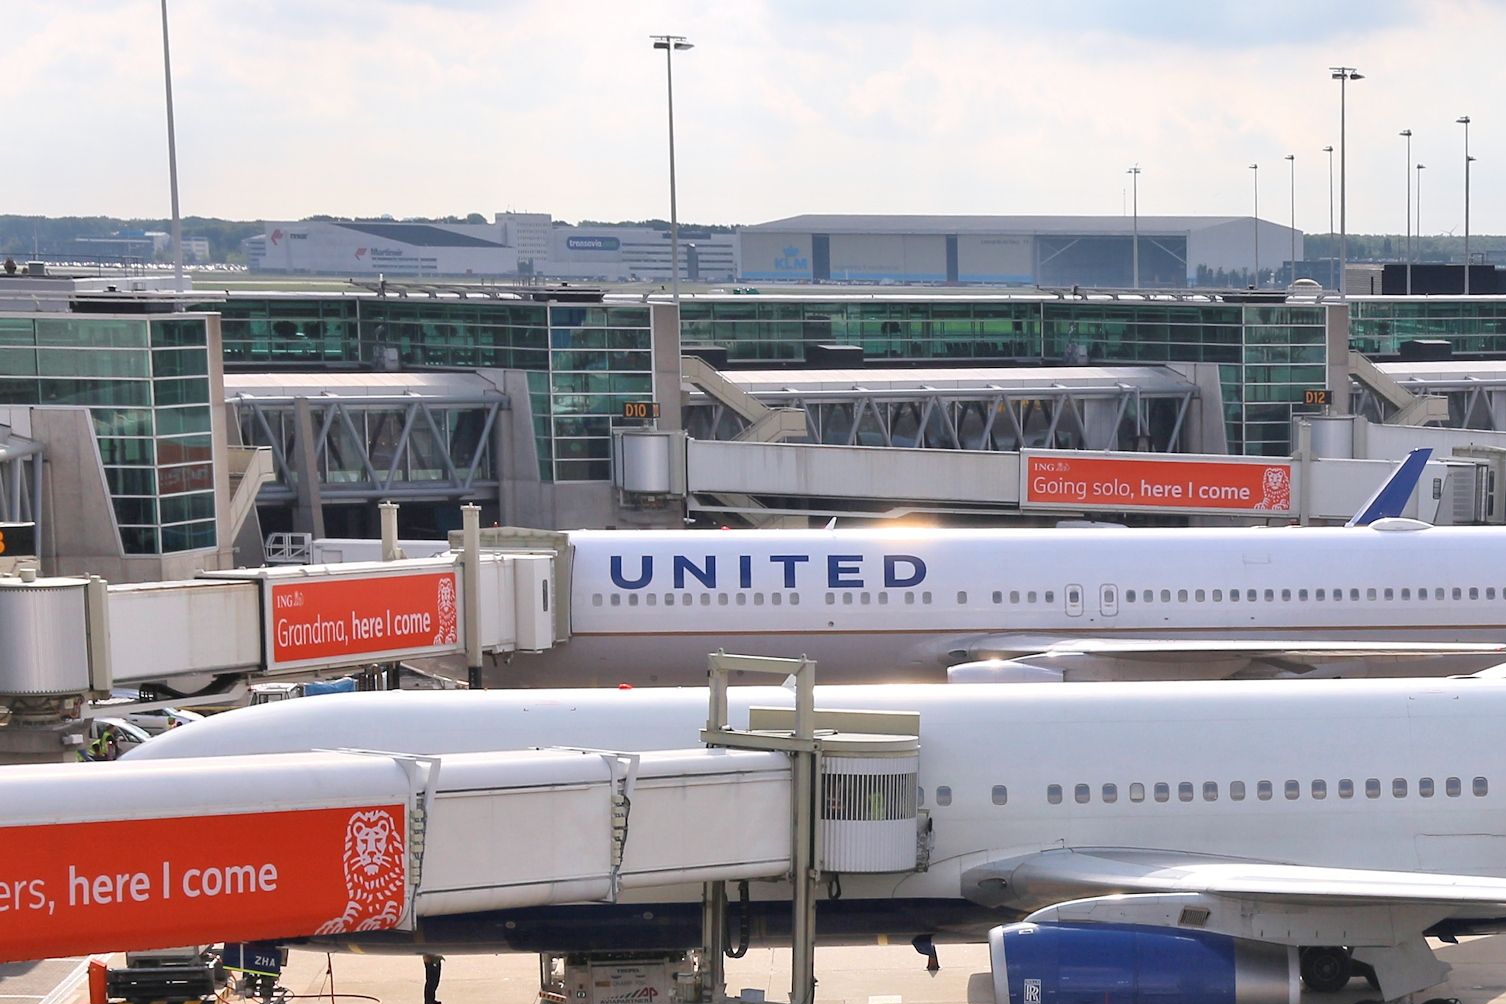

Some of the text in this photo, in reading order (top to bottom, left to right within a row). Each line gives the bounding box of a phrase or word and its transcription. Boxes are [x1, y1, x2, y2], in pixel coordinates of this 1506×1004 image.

[1306, 391, 1325, 404] D12
[625, 403, 647, 417] D10
[1034, 463, 1055, 471] ING
[1033, 476, 1250, 500] Going solo, here I come
[610, 555, 927, 590] UNITED
[277, 595, 293, 608] ING
[277, 609, 431, 648] Grandma, here I come
[68, 864, 150, 906] here
[162, 861, 170, 899] I
[182, 862, 278, 898] come
[254, 955, 276, 967] ZHA
